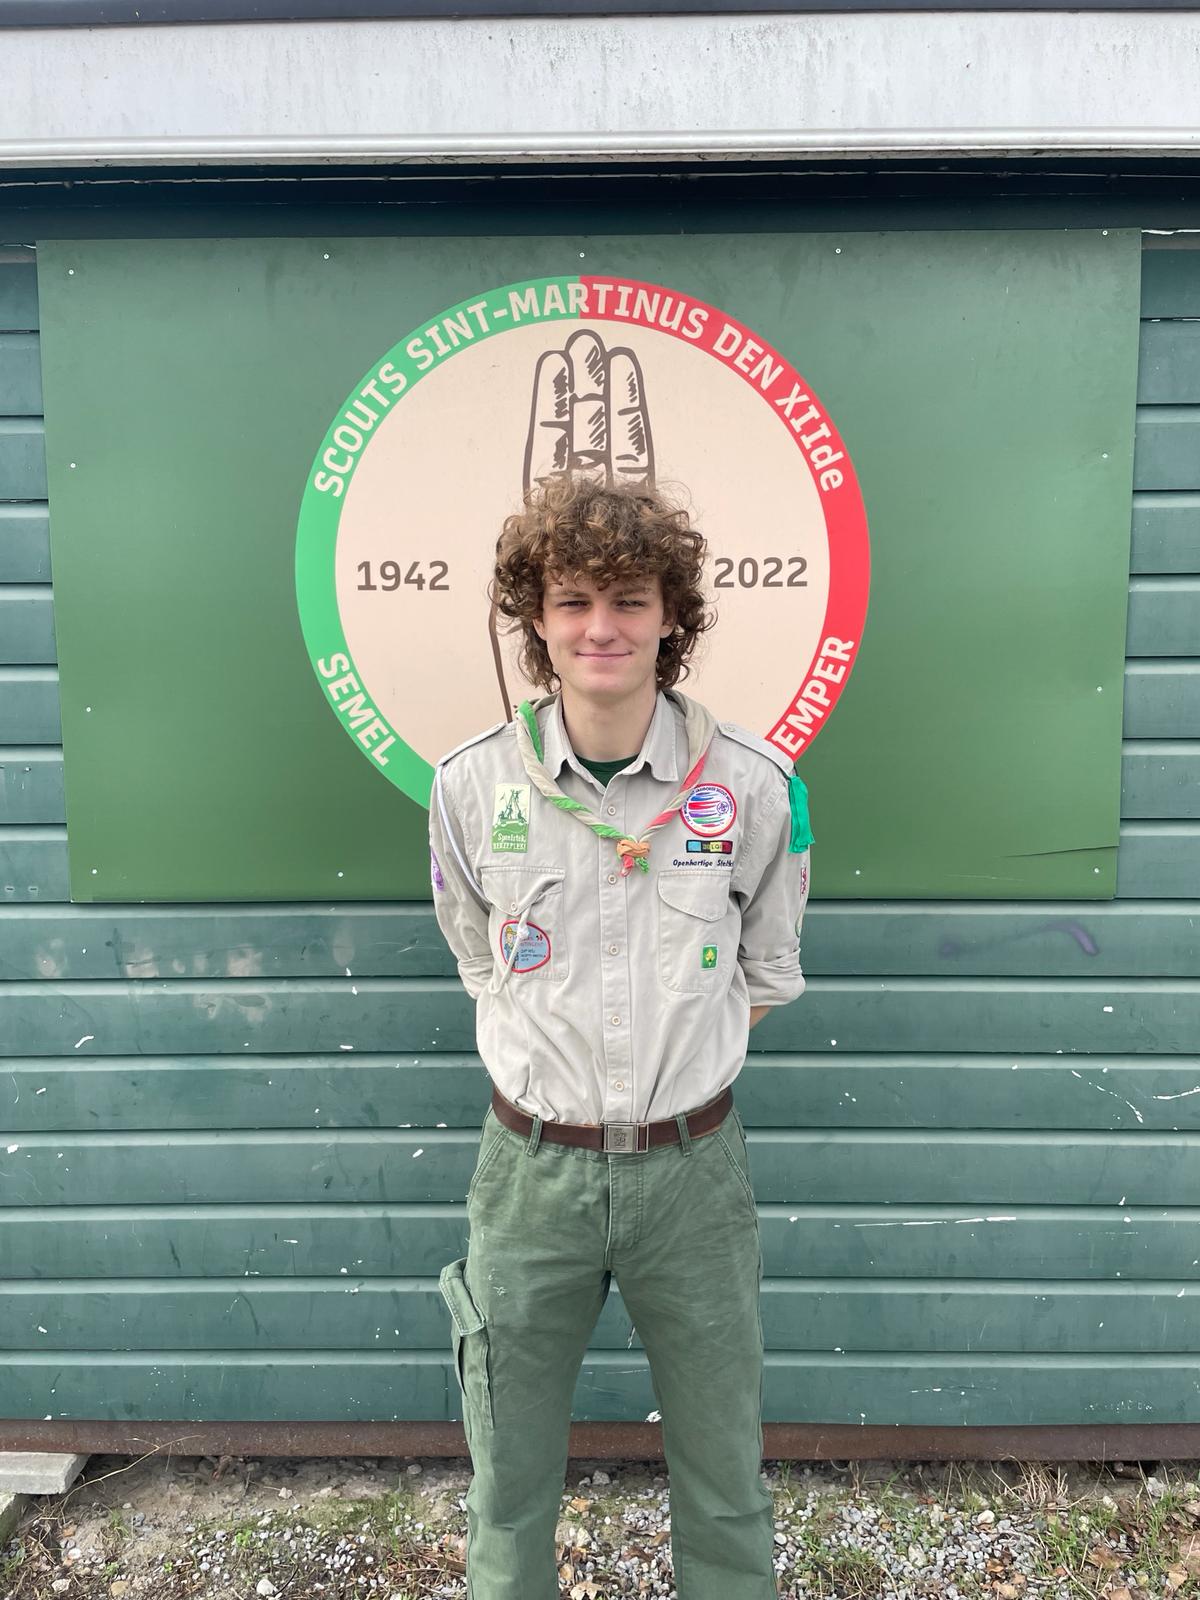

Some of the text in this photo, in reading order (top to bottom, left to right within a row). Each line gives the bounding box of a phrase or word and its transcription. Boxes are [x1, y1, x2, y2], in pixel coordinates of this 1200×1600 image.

[313, 282, 844, 498] SCOUTS SINT-MARTINUS DEN XIIde
[356, 560, 450, 592] 1942
[713, 556, 809, 589] 2022
[316, 652, 397, 767] SEMEL
[771, 636, 855, 755] EMPER
